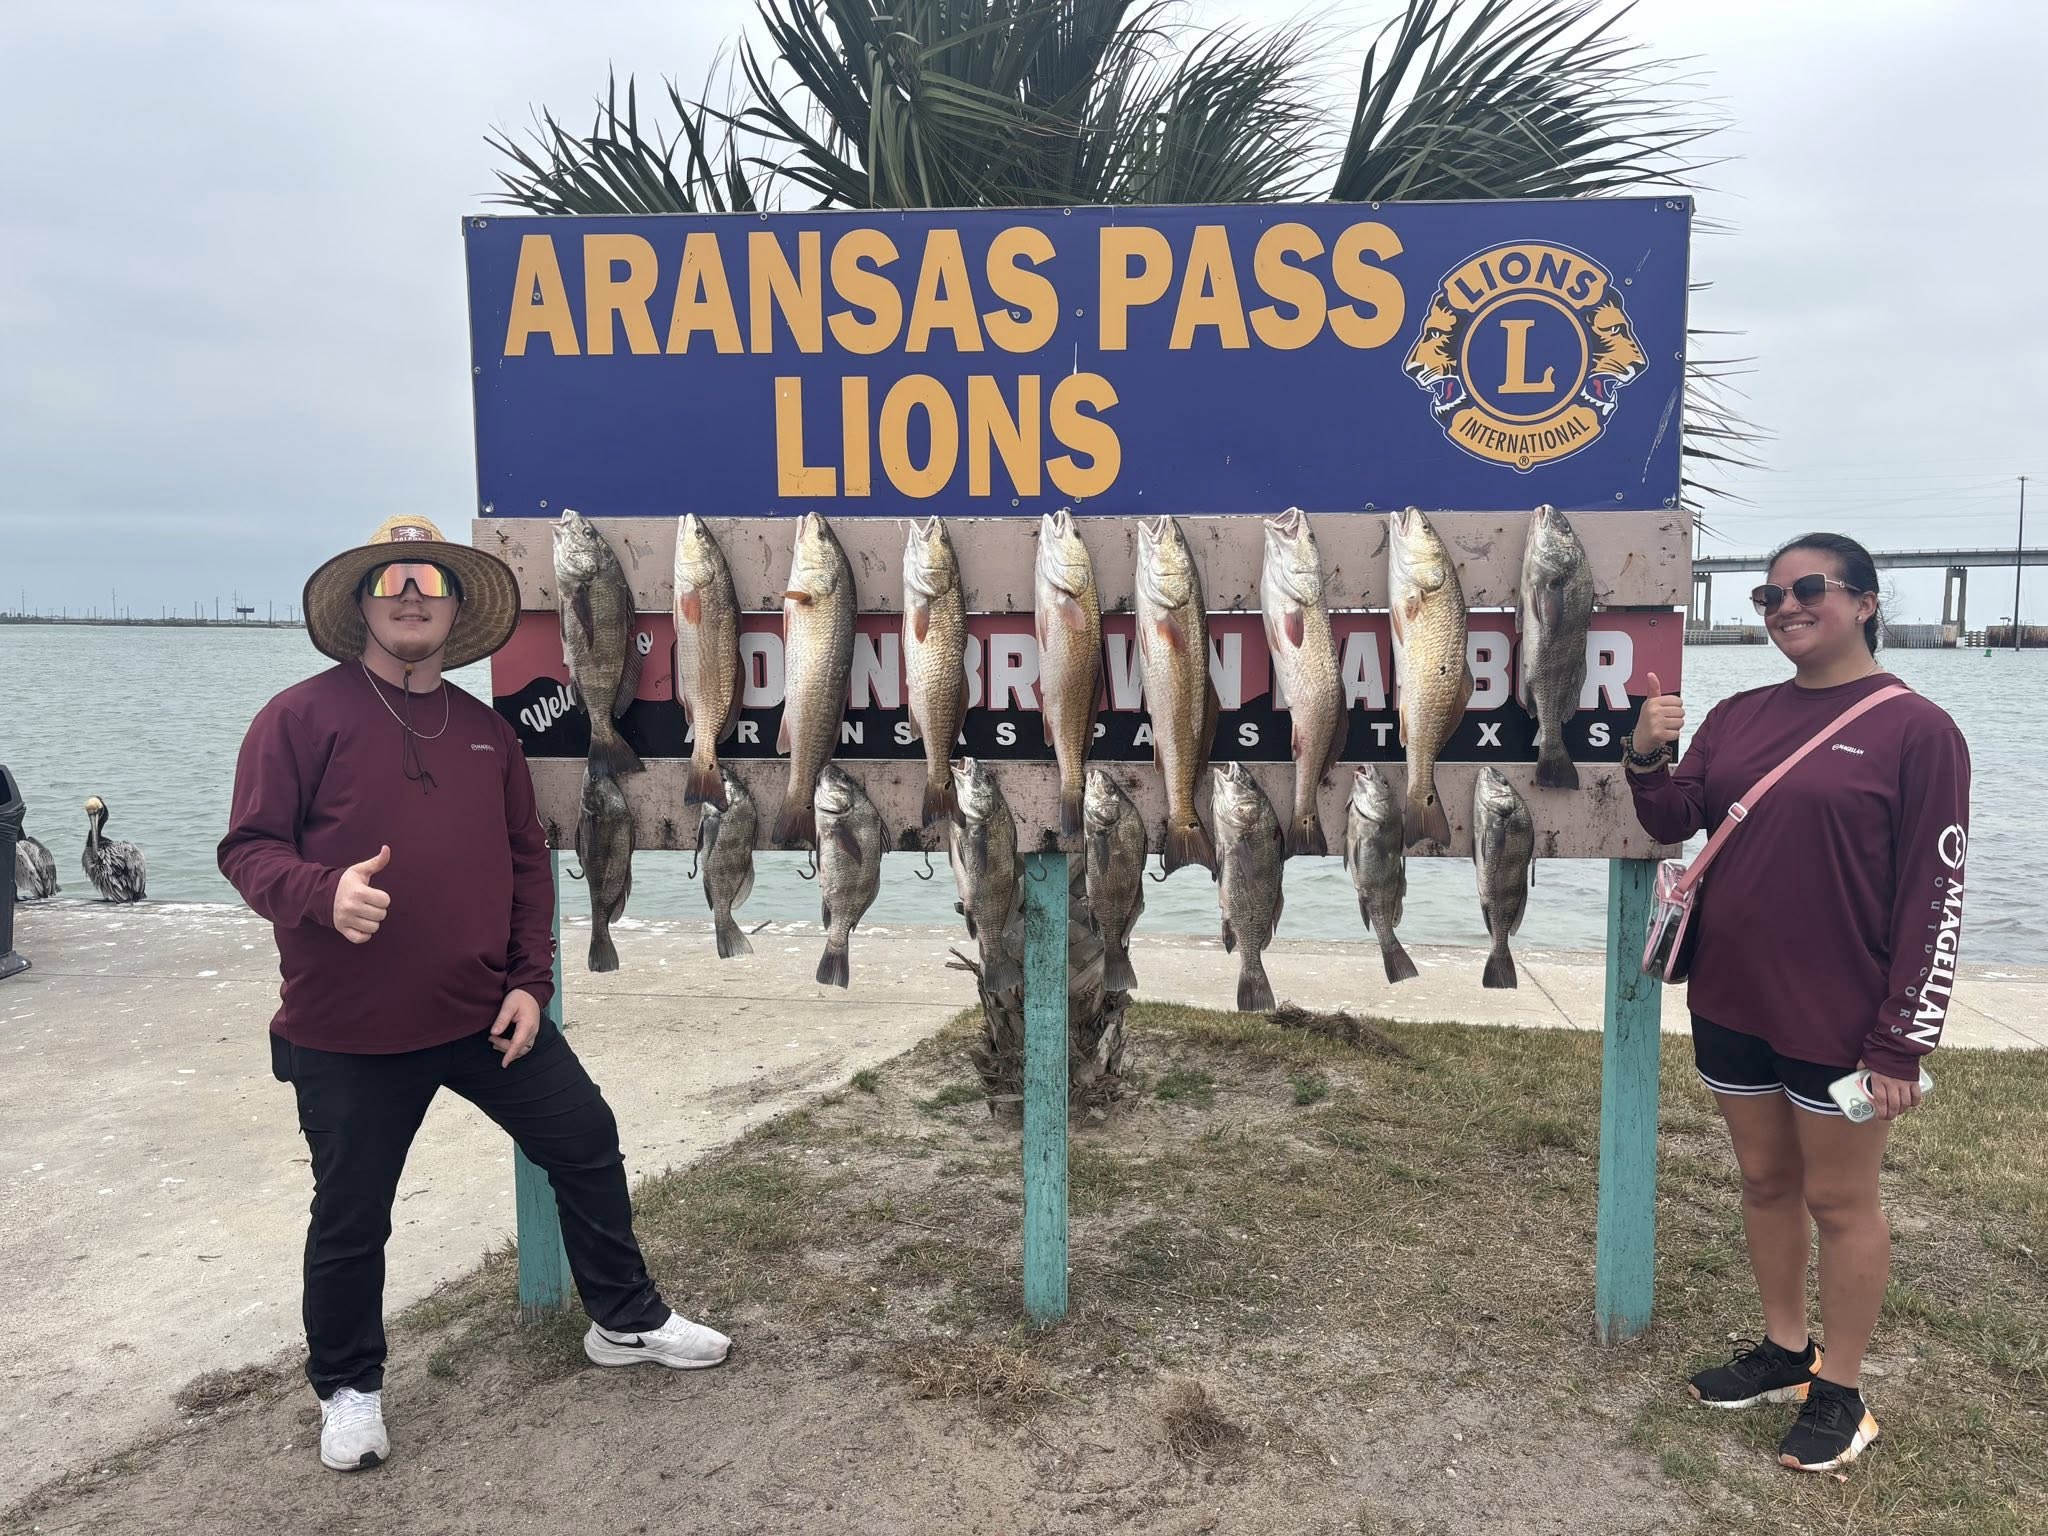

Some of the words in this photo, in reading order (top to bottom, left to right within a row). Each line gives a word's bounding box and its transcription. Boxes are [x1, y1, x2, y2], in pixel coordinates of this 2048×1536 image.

[504, 226, 1059, 356] ARANSAS
[1099, 222, 1405, 351] PASS
[1454, 252, 1598, 304] LIONS
[1498, 319, 1555, 393] L
[775, 373, 1121, 498] LIONS
[1459, 416, 1590, 454] INTERNATIONAL
[1371, 722, 1611, 747] TXS
[1891, 876, 1944, 1036] OUTDOORS
[1905, 877, 1963, 1048] MAGELLAN
